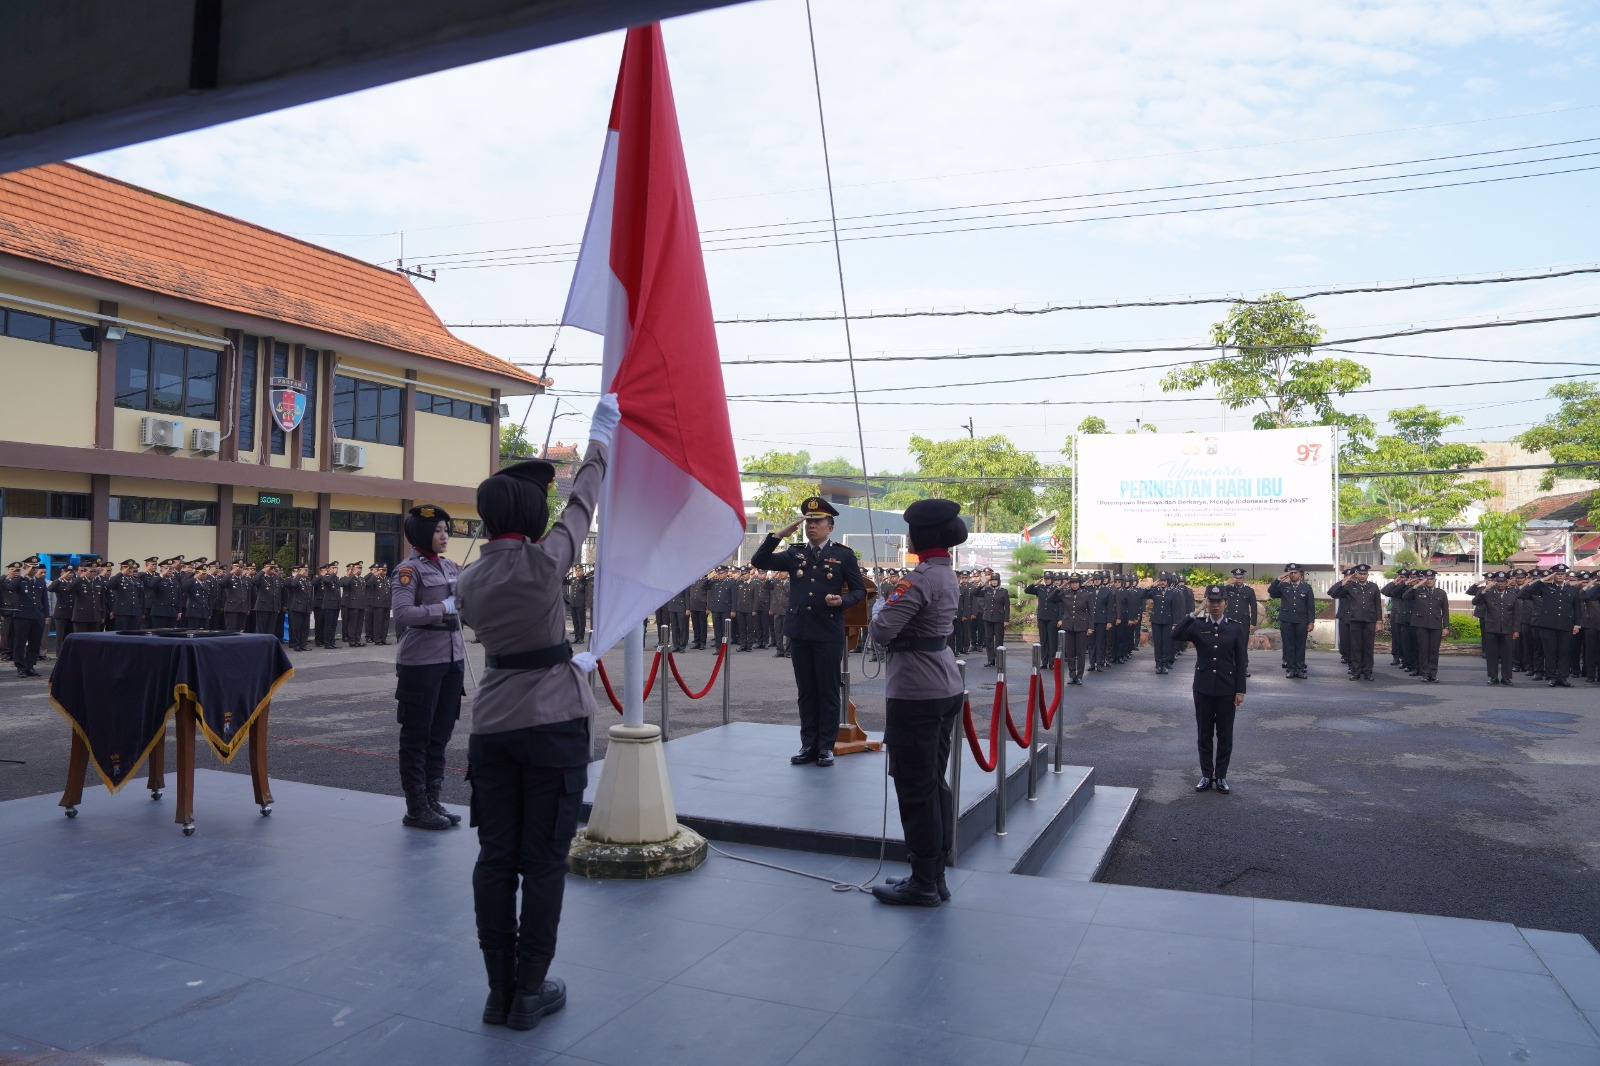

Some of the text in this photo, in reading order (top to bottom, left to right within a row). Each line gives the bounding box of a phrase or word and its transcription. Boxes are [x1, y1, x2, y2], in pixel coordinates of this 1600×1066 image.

[1297, 443, 1323, 462] 97
[1120, 477, 1283, 499] PERINGATAN HARI IBU
[1209, 498, 1234, 506] Menuju
